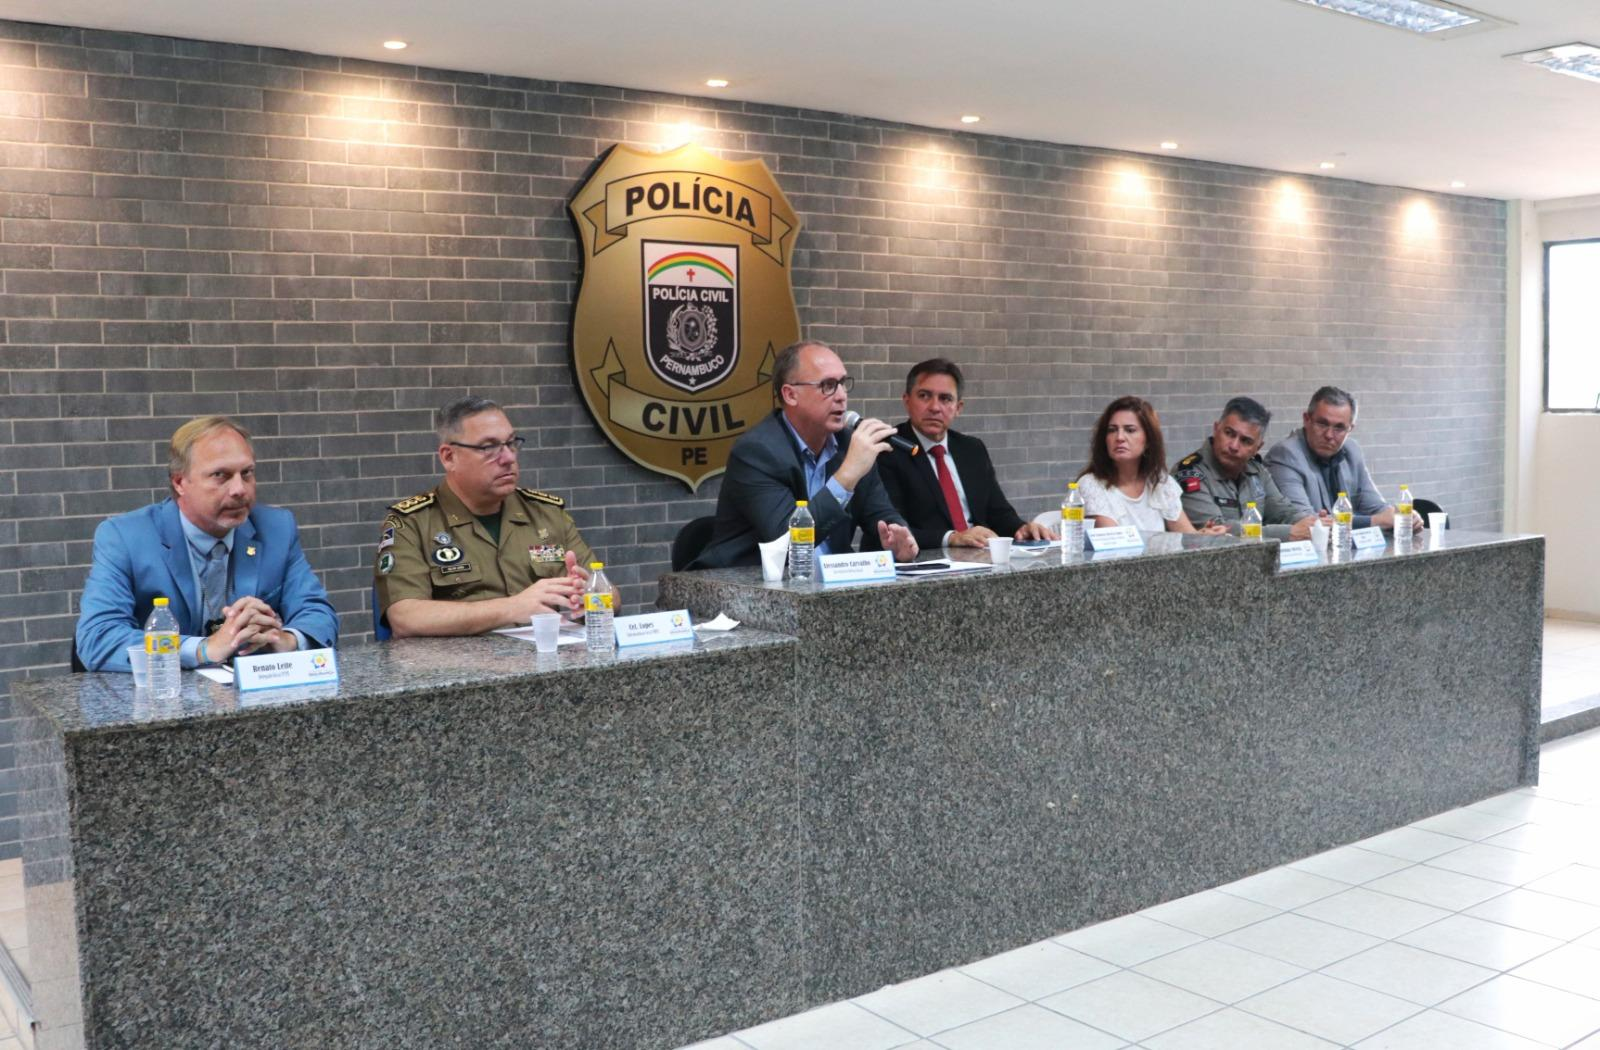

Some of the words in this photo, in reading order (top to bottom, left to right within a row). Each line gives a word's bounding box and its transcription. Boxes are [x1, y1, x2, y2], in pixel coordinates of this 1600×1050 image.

[626, 177, 755, 227] POLÍCIA
[652, 285, 698, 301] POLÍCIA
[700, 289, 729, 303] CIVIL
[659, 354, 725, 376] PERNAMBUCO
[642, 402, 745, 435] CIVIL
[681, 447, 708, 466] PE
[252, 663, 276, 673] Renato
